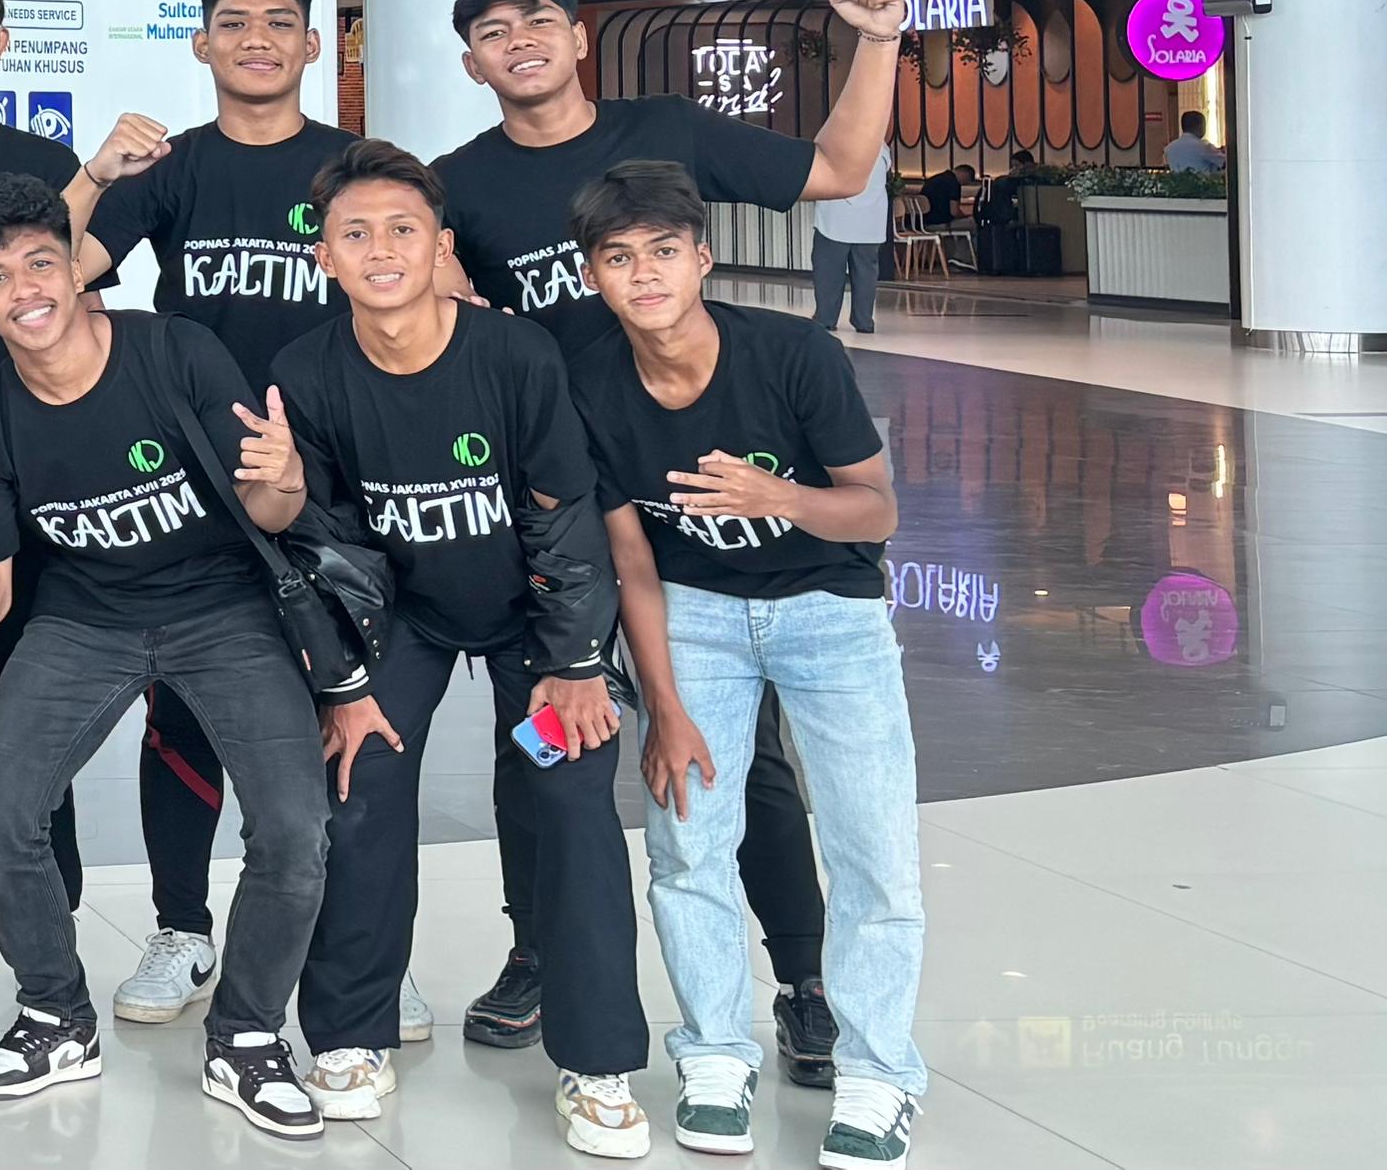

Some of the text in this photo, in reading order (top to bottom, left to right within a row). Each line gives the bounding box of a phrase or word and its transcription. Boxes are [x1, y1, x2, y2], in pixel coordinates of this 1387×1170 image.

[8, 8, 77, 21] NEEDS SERVICE
[14, 40, 88, 55] PENUMPANG
[1147, 33, 1207, 65] SOLARIA
[34, 59, 85, 74] KHUSUS
[183, 238, 230, 250] POPNAS
[276, 241, 300, 253] XVII
[507, 246, 555, 269] POPNAS
[183, 250, 328, 305] KALTIM
[79, 488, 134, 509] JAKARTA
[132, 480, 159, 496] XVII
[391, 483, 448, 495] JAKARTA
[449, 478, 477, 490] XVII
[36, 480, 207, 549] KALTIM
